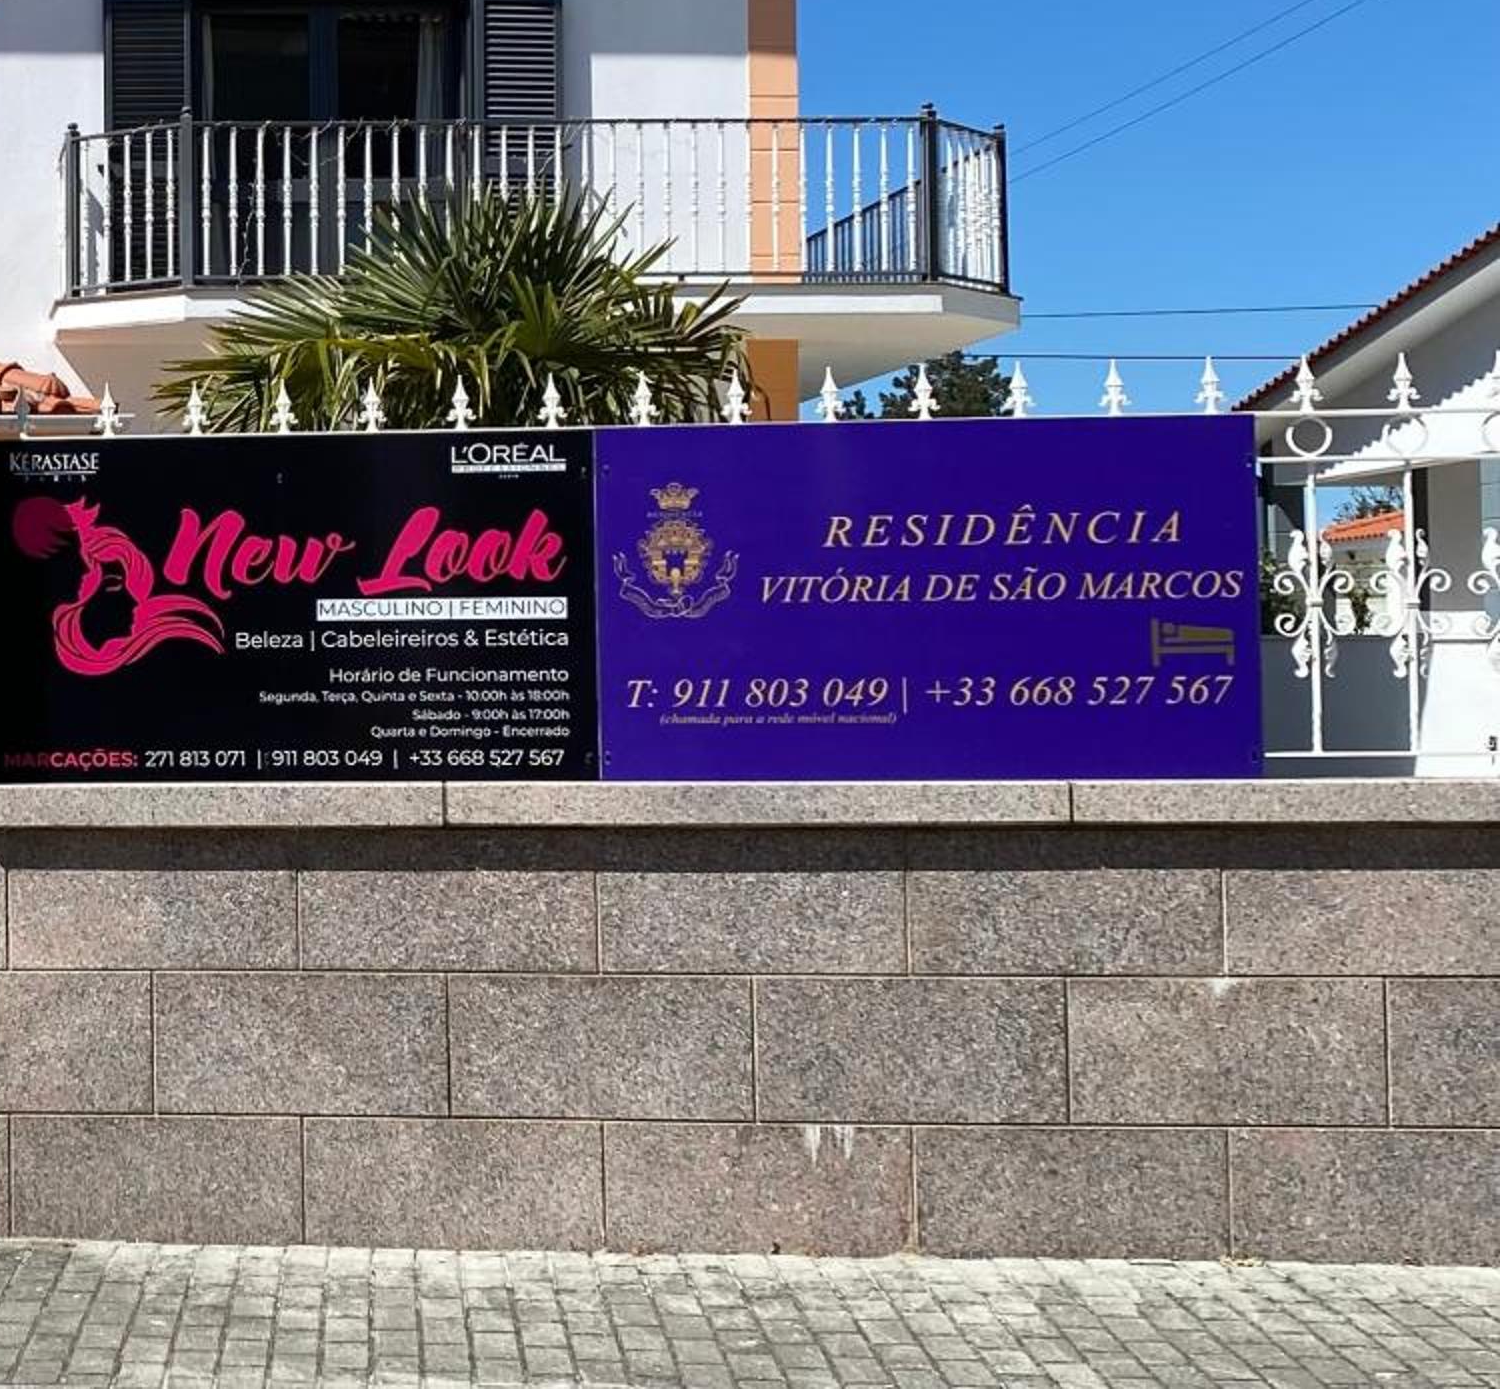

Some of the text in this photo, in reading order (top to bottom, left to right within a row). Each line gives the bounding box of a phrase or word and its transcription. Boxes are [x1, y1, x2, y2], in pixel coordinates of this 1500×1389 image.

[822, 504, 1182, 548] RESIDÊNCIA
[163, 507, 567, 599] New Look
[760, 567, 1244, 604] VITÓRIA DE SÃO MARCOS
[319, 601, 443, 617] MASCULINO
[460, 599, 566, 615] FEMININO
[235, 631, 304, 649] Beleza
[321, 628, 459, 648] Cabeleireiros
[485, 628, 569, 647] Estética
[329, 667, 569, 684] Horário de Funcionamento
[361, 690, 405, 703] Quinta
[408, 692, 417, 701] e
[419, 690, 455, 701] Sexta
[627, 680, 658, 708] T:
[672, 678, 730, 707] 911
[745, 678, 809, 707] 803
[823, 677, 888, 707] 049
[925, 676, 996, 706] +33
[1009, 676, 1075, 706] 668
[1087, 676, 1154, 705] 527
[1165, 675, 1233, 705] 567
[371, 726, 416, 739] Quarta
[418, 727, 427, 738] e
[429, 726, 491, 739] Domingo
[502, 726, 570, 737] Encerrado
[144, 751, 174, 767] 271
[179, 751, 210, 767] 813
[215, 751, 245, 767] 071
[271, 750, 297, 766] 911
[303, 750, 340, 766] 803
[345, 750, 383, 766] 049
[409, 750, 442, 766] +33
[447, 750, 485, 766] 668
[489, 749, 524, 766] 527
[528, 749, 565, 766] 567
